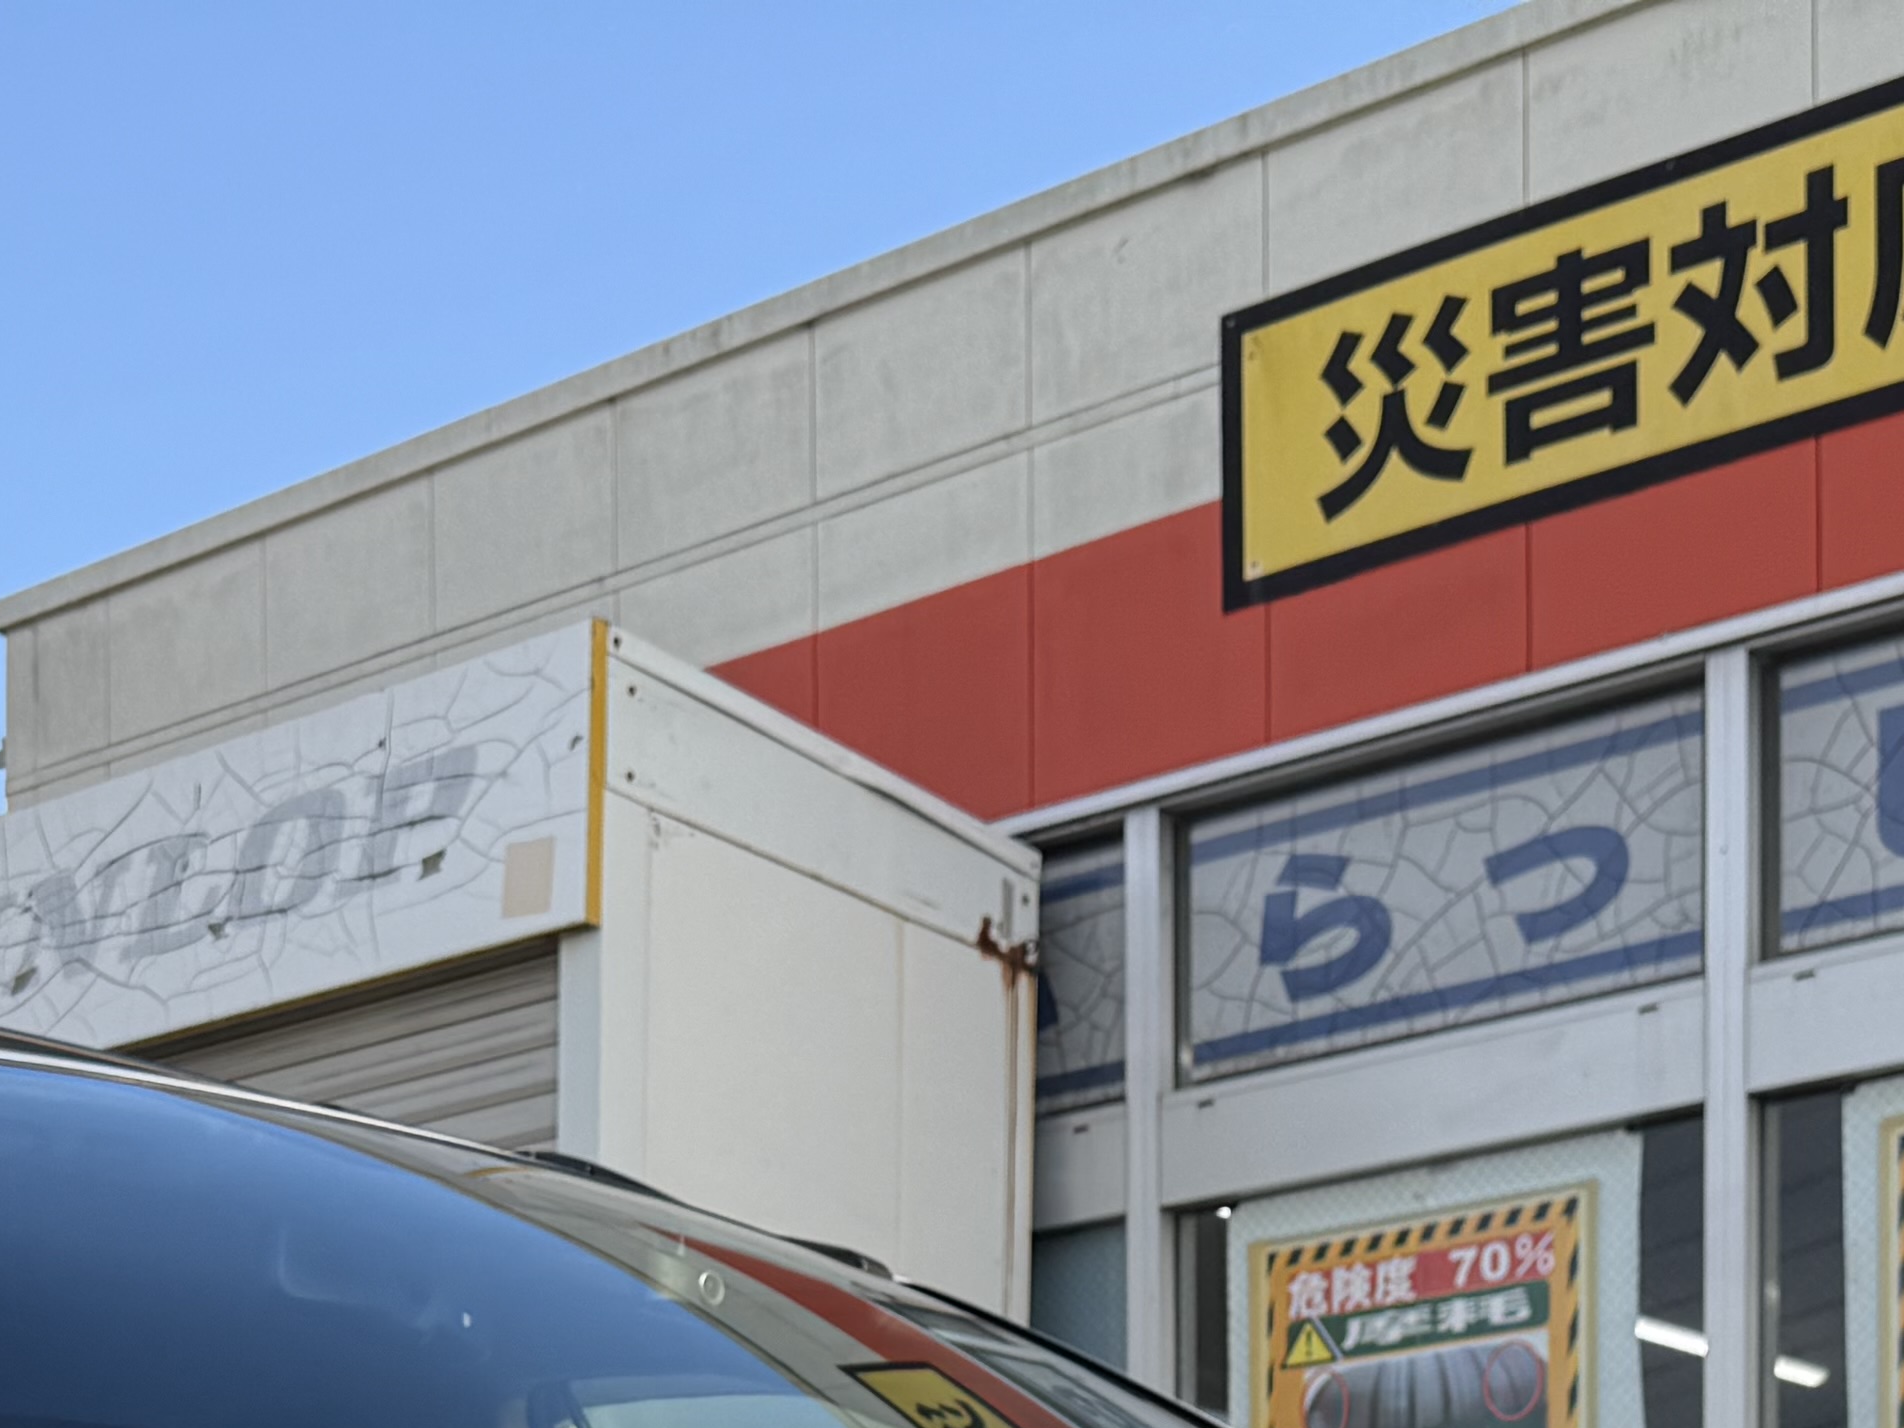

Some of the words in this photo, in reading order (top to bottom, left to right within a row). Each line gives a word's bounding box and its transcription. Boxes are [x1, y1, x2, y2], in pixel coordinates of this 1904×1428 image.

[1287, 1255, 1418, 1318] 危険度
[1448, 1231, 1556, 1288] 70%
